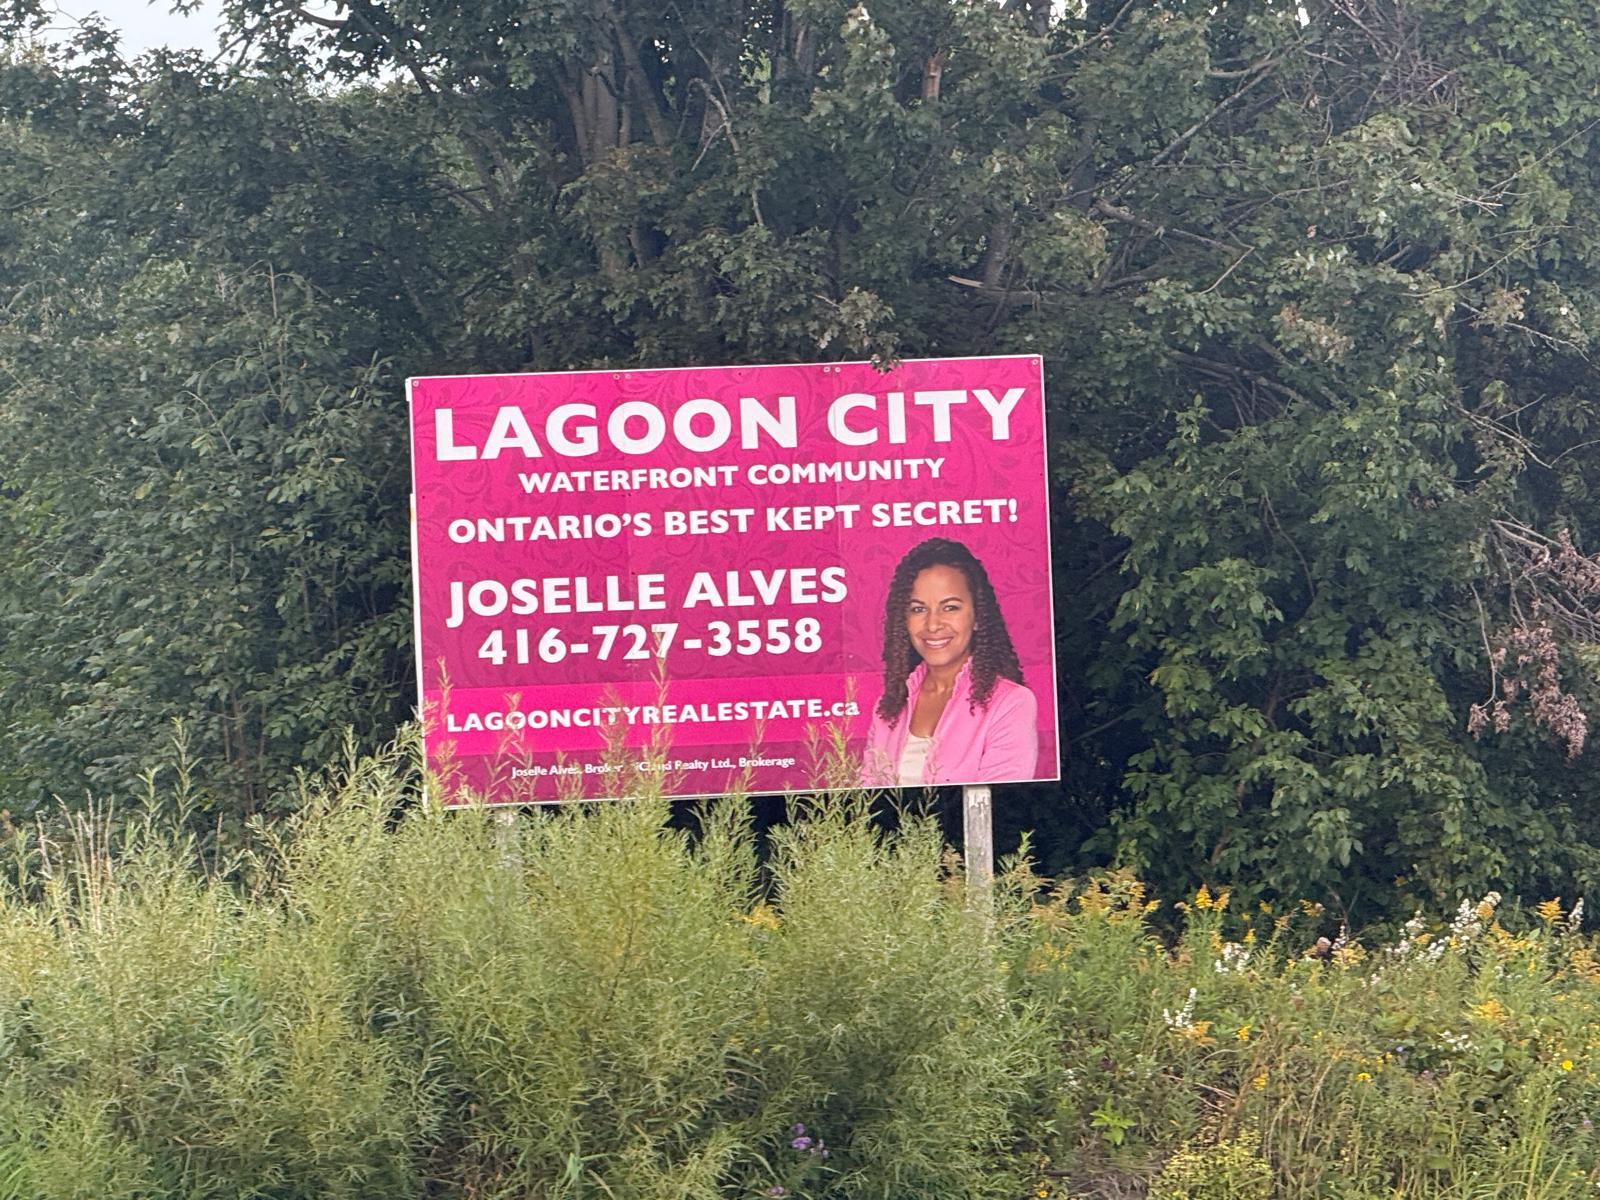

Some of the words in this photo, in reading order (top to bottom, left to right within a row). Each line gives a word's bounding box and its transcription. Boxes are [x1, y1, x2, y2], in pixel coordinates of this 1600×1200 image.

[435, 396, 797, 461] LAGOON
[827, 388, 1027, 446] CITY
[518, 465, 739, 494] WATERFRONT
[747, 457, 946, 485] COMMUNITY
[448, 512, 652, 543] ONTARIO’S
[664, 508, 755, 536] BEST
[766, 504, 861, 532] KEPT
[871, 498, 1018, 528] SECRET!
[445, 573, 667, 628] JOSELLE
[682, 566, 848, 609] ALVES
[477, 617, 823, 665] 416-727-3558
[447, 698, 861, 733] LAGOONCITYREALESTATE.ca
[511, 765, 548, 779] Joselle
[674, 757, 709, 772] Realty
[711, 757, 737, 769] Ltd.,
[738, 756, 796, 769] Brokerage
